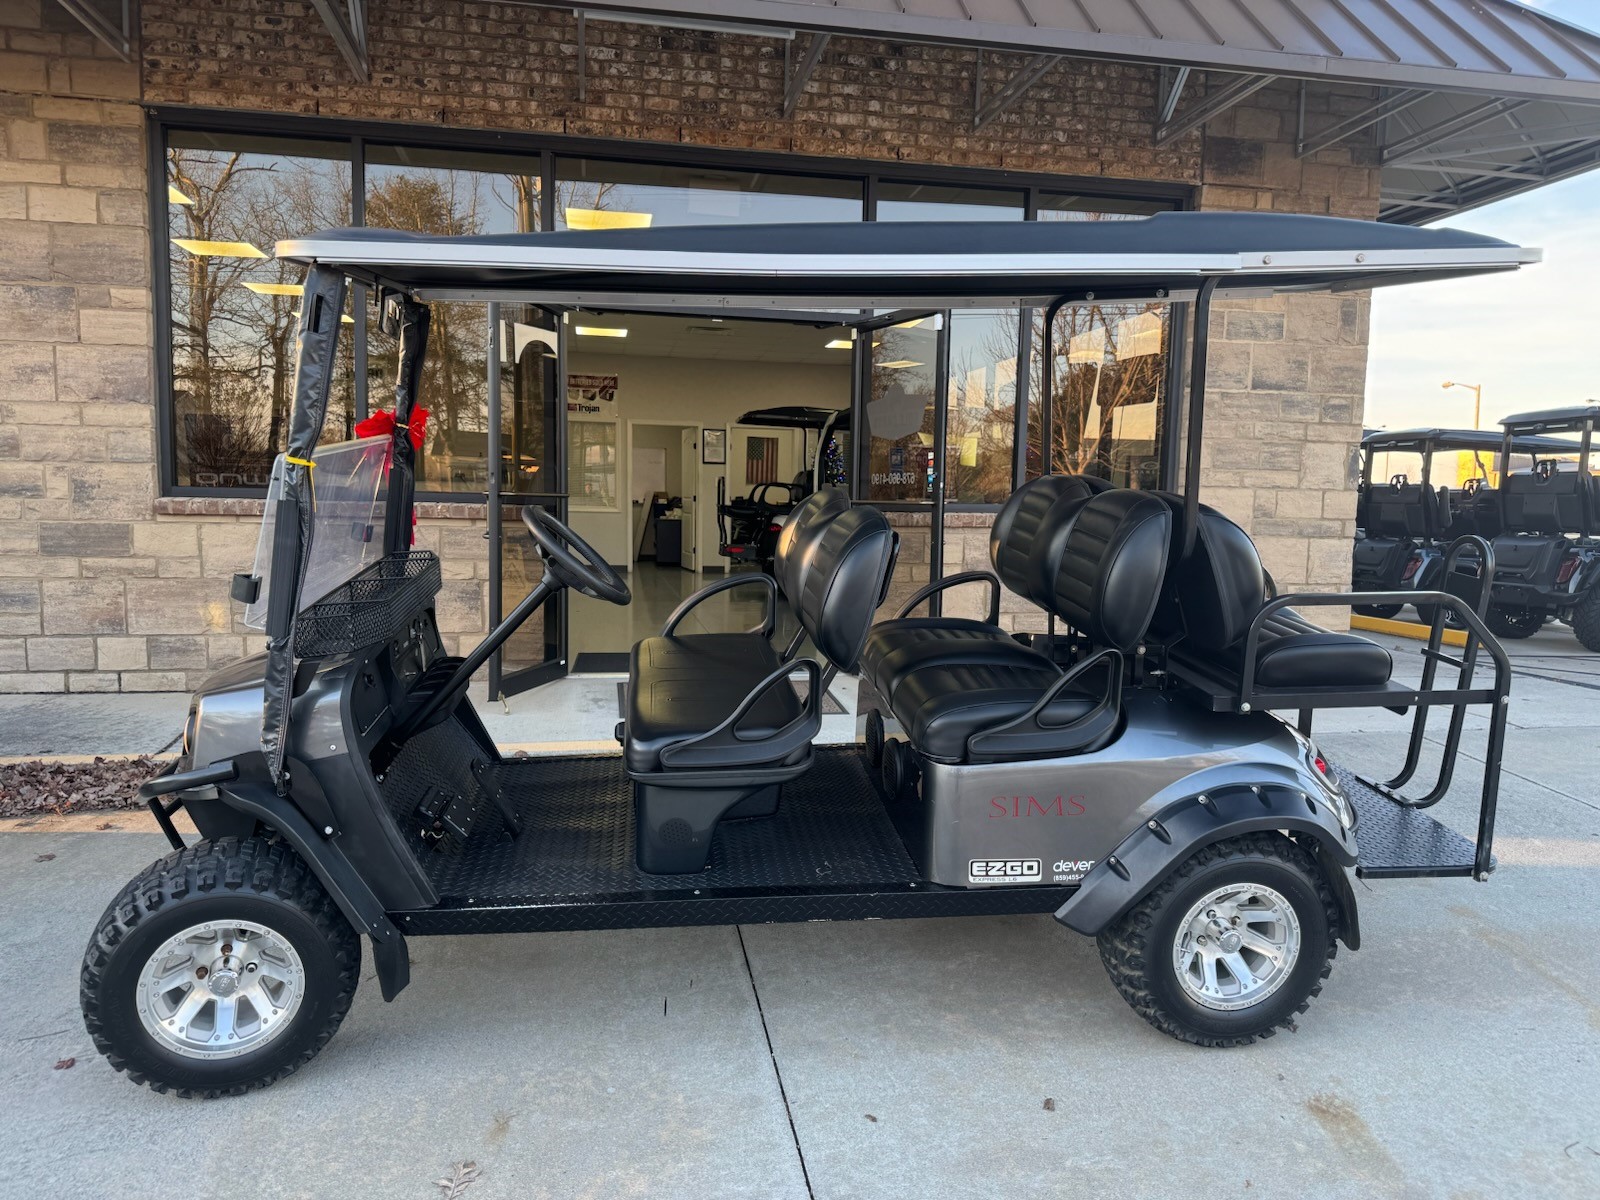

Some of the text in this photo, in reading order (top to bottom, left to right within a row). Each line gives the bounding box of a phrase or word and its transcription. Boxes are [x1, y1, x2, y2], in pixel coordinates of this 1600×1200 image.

[578, 404, 600, 414] Trojan
[989, 795, 1086, 818] SIMS
[972, 861, 1039, 876] EZGO
